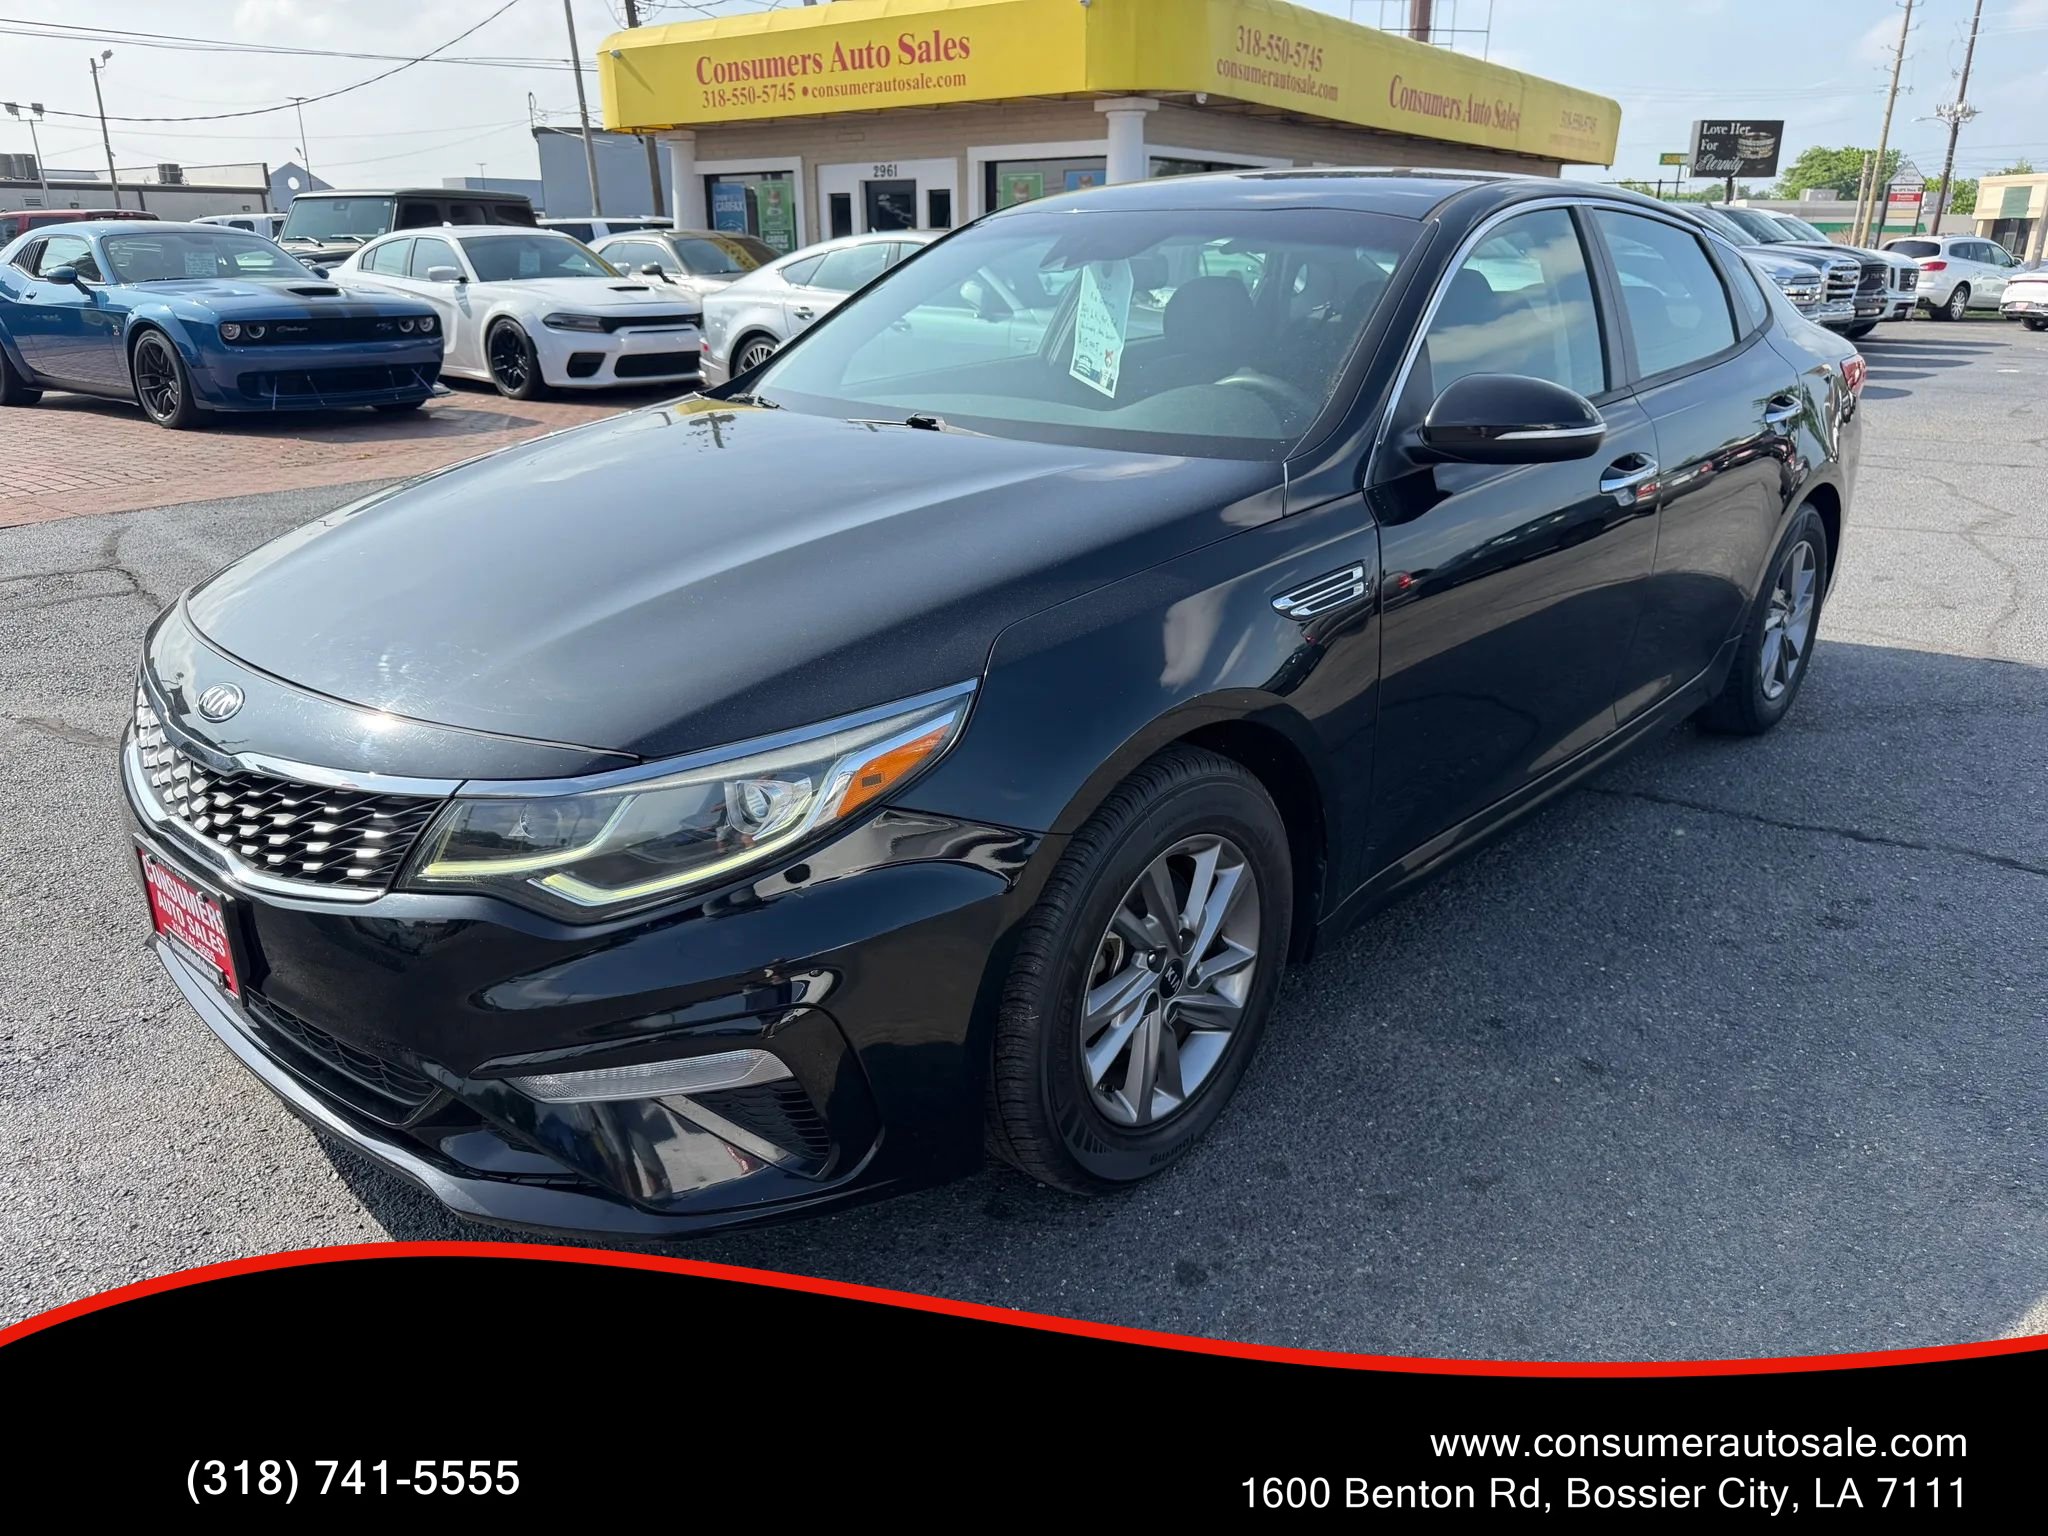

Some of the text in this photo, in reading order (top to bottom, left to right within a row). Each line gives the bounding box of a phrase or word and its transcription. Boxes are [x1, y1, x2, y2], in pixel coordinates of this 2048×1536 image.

[696, 30, 970, 86] Consumers Auto Sales
[1236, 25, 1323, 72] 318-550-5745
[702, 72, 966, 109] 318-550-5745 consumerautosale.com
[1216, 58, 1338, 101] consumerautosale.com
[1389, 74, 1521, 131] Consumers Auto Sales
[1700, 139, 1719, 151] For
[1702, 122, 1751, 135] Love Her
[873, 164, 897, 178] 2961
[1695, 153, 1744, 177] Eternity
[142, 854, 226, 939] CONSUMERS
[157, 891, 226, 958] AUTO SALES
